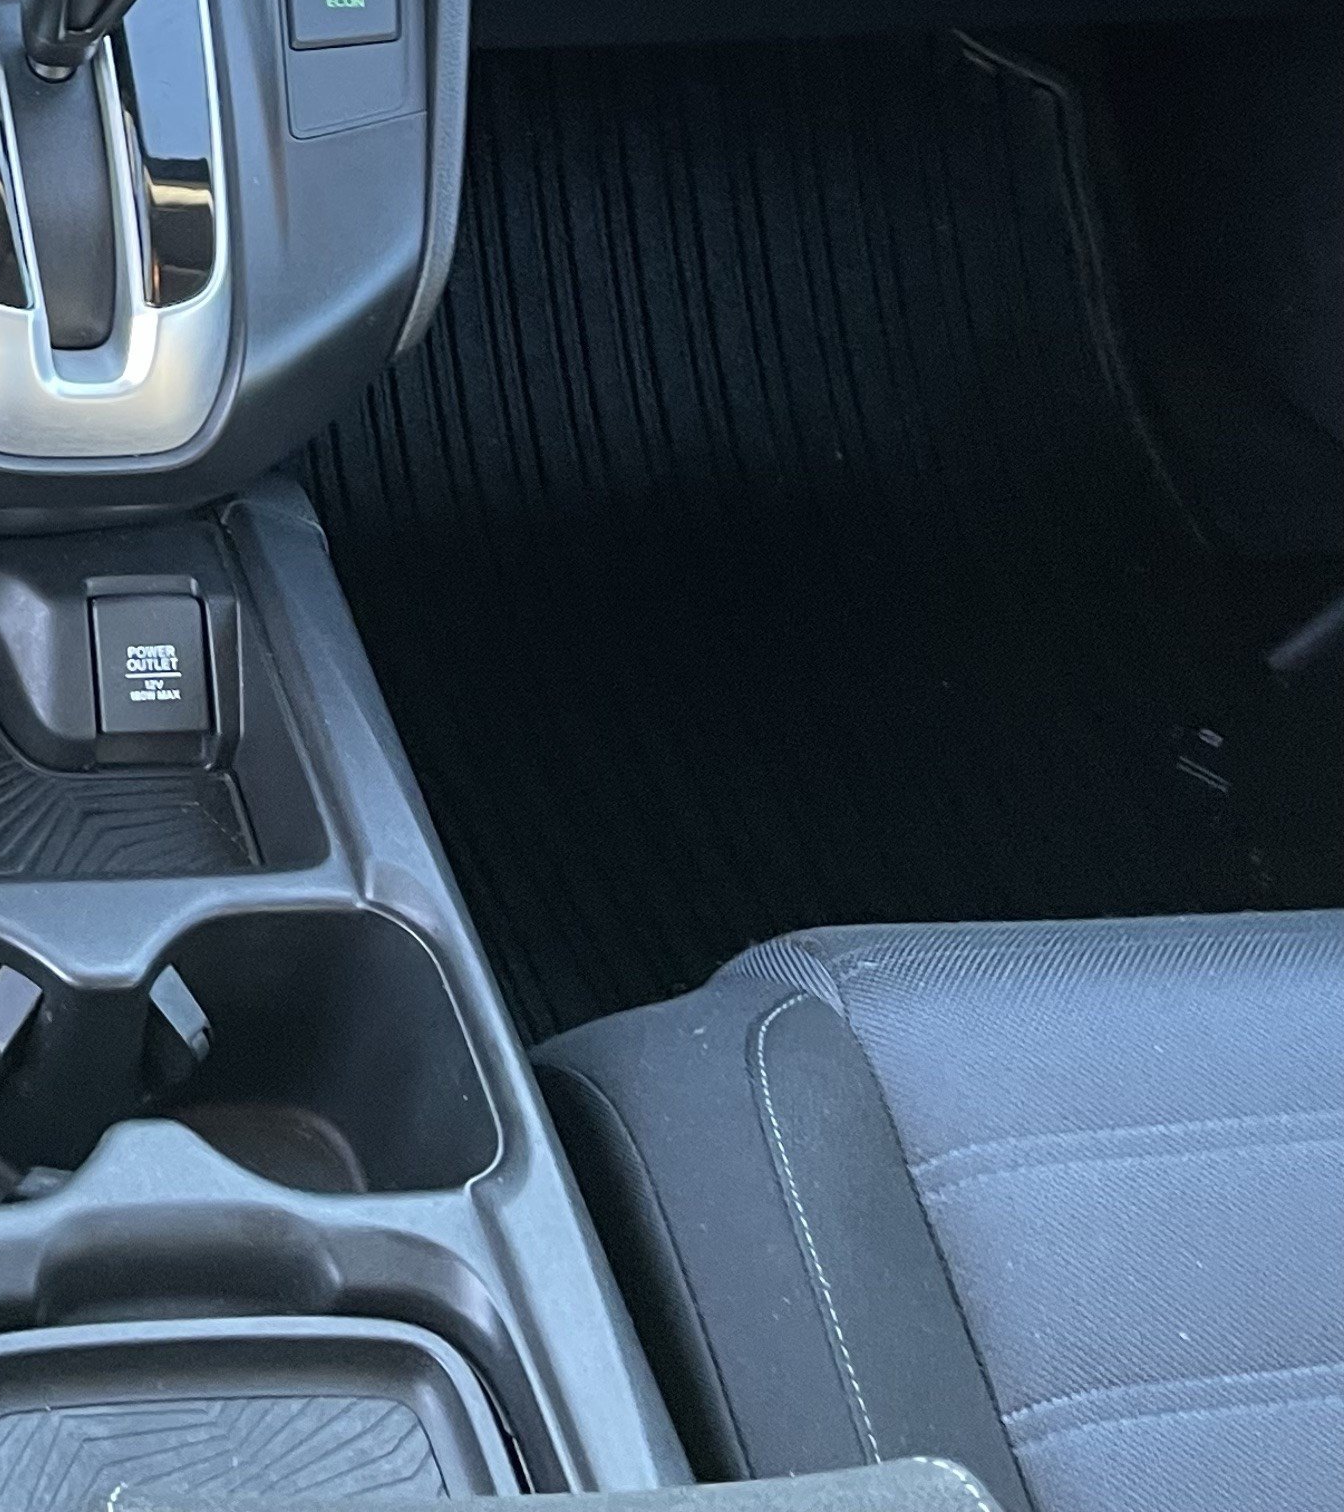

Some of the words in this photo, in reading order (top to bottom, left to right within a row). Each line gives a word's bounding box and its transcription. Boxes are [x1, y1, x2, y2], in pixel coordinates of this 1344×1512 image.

[127, 645, 176, 658] POWER
[126, 658, 178, 671] OUTLET
[156, 689, 181, 700] MAX
